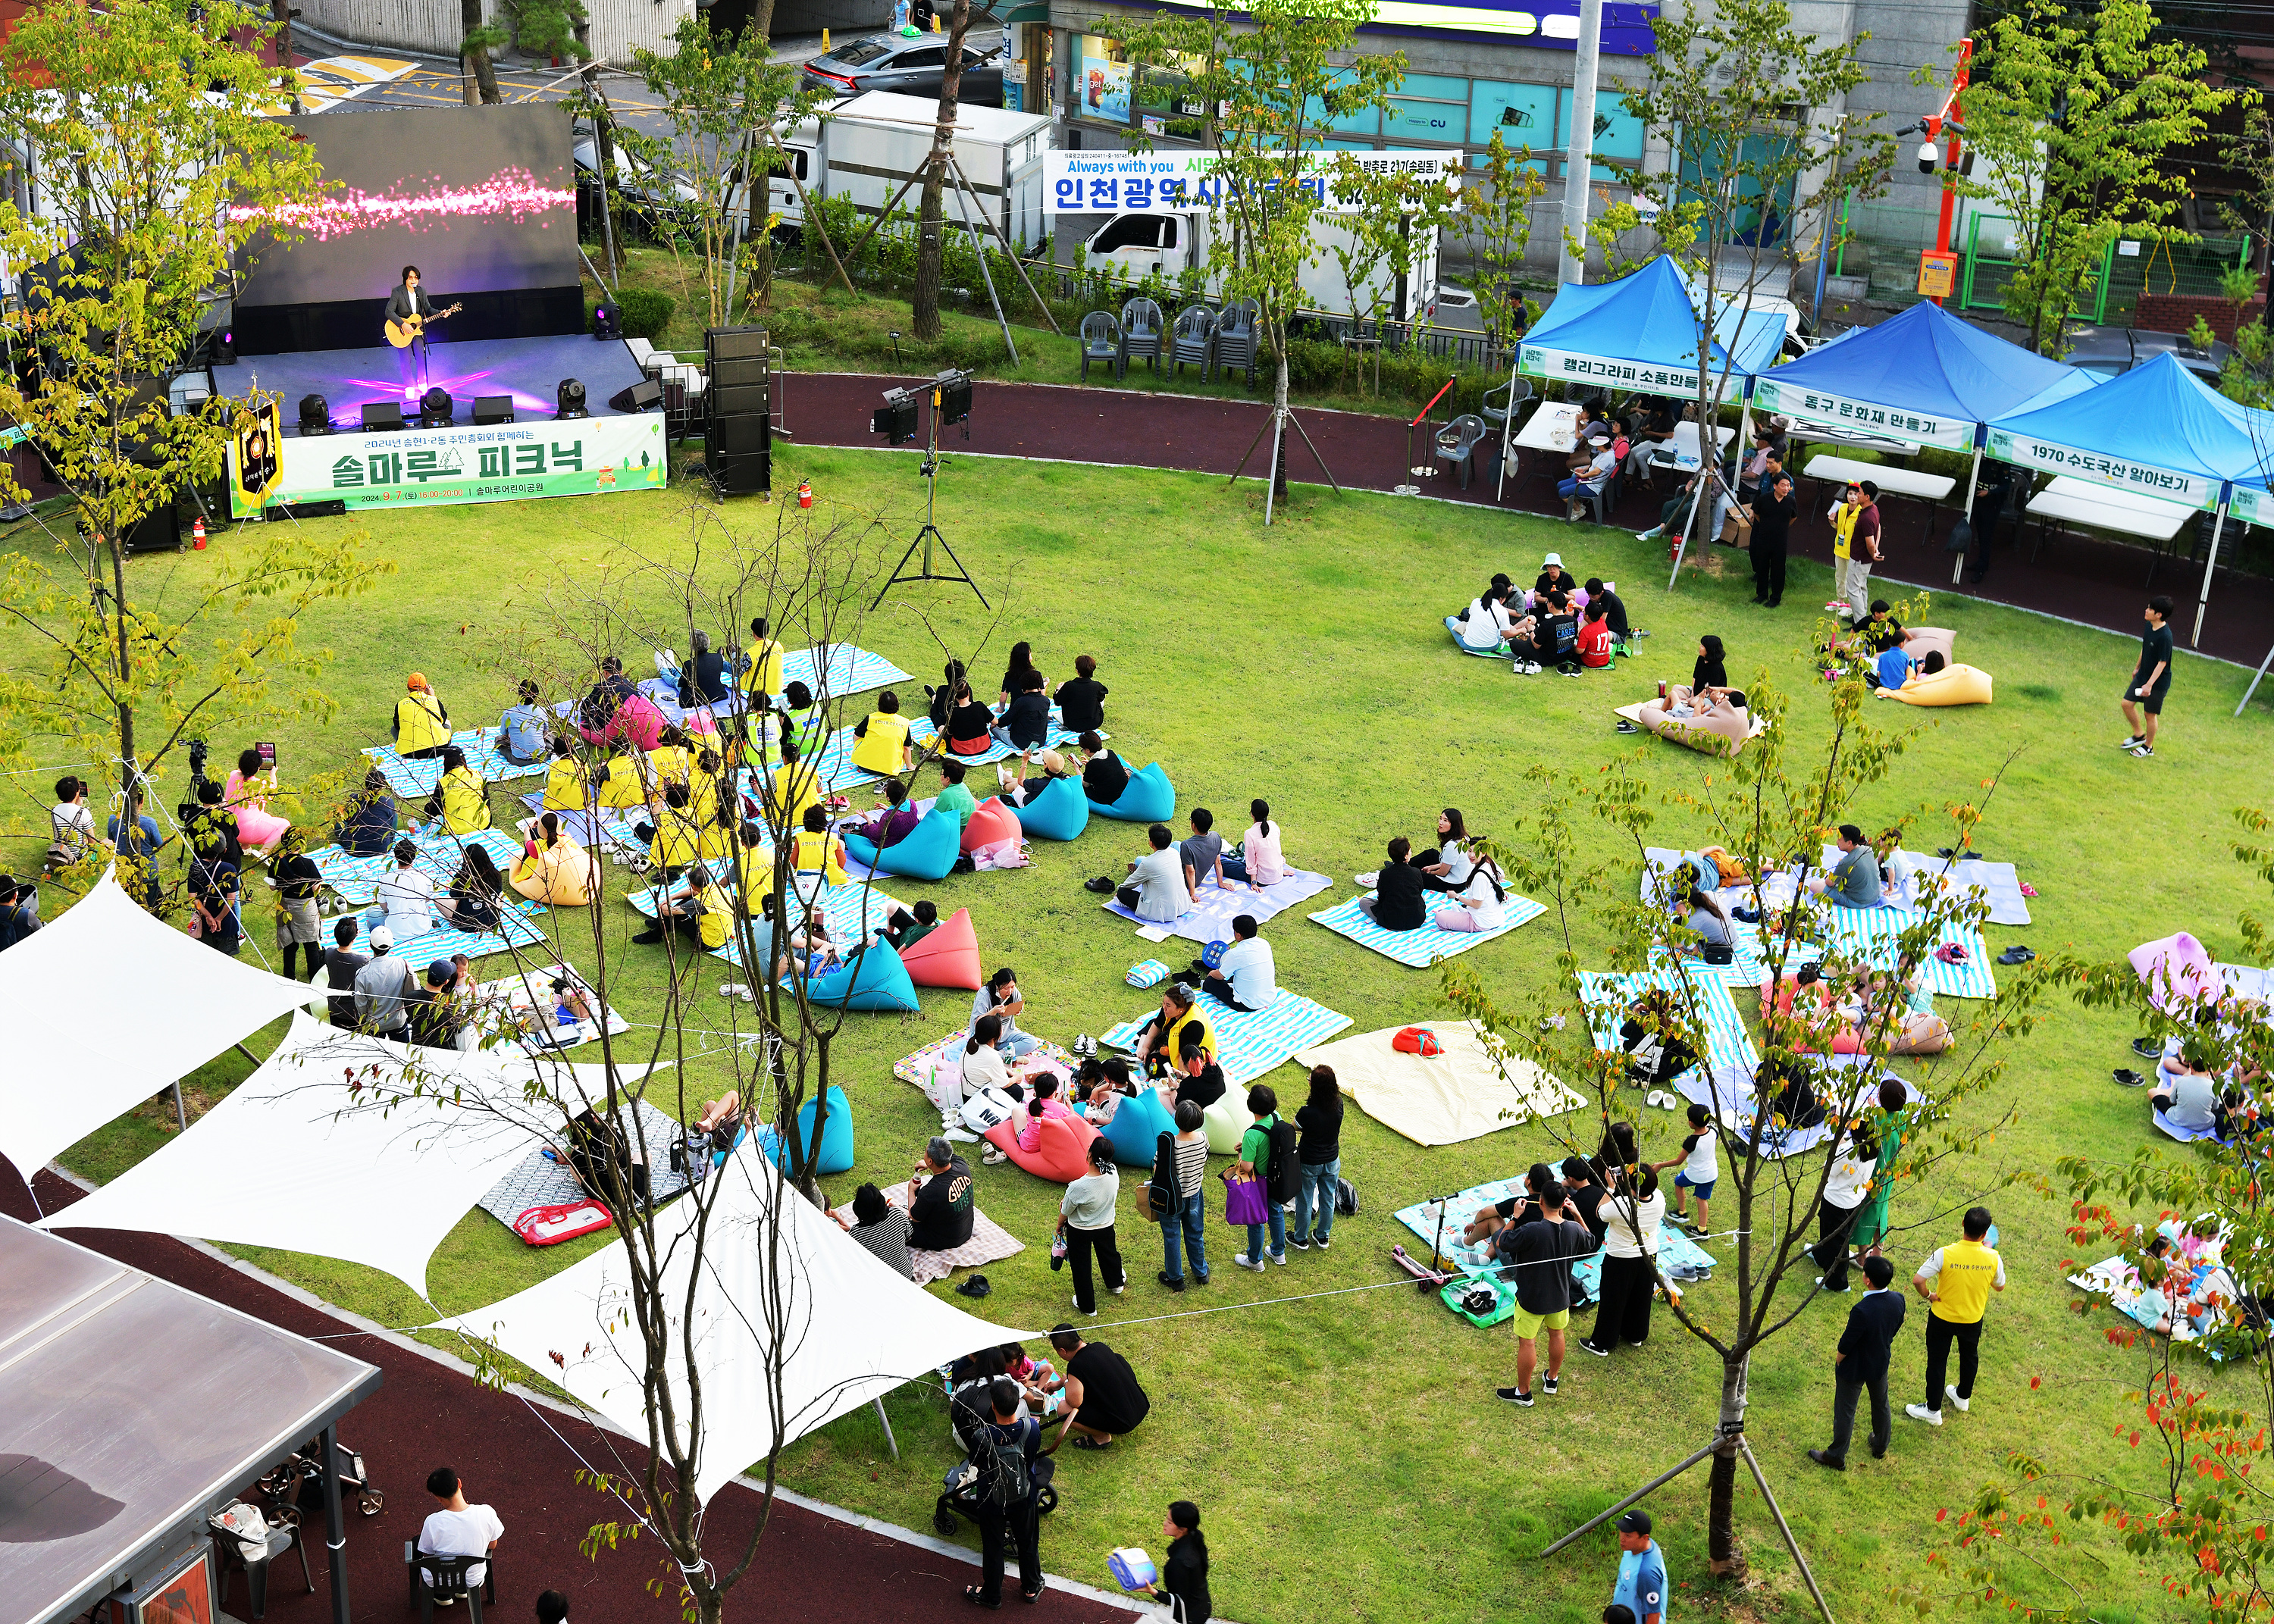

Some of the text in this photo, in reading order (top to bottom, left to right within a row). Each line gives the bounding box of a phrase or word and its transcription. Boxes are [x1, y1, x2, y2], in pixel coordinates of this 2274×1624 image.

[1430, 119, 1446, 128] CU
[1067, 160, 1174, 176] Always with you
[1564, 358, 1637, 380] 캘리그라피
[1805, 395, 1834, 412] 동구
[1839, 402, 1885, 424] 문화재
[1890, 414, 1936, 434] 만들기
[449, 433, 495, 445] 주민총회와
[496, 430, 535, 442] 함께하는
[332, 440, 583, 489] 솔마루 피크닉
[2031, 445, 2065, 462] 1970
[2067, 453, 2127, 478] 수도국산
[2130, 467, 2189, 493] 알아보기
[361, 494, 382, 502] 2024.
[418, 489, 464, 499] 16:00~20:00
[476, 483, 544, 496] 솔마루어린이공원
[1556, 627, 1575, 638] CARES
[1596, 632, 1608, 651] 17
[948, 1175, 972, 1203] GOOD
